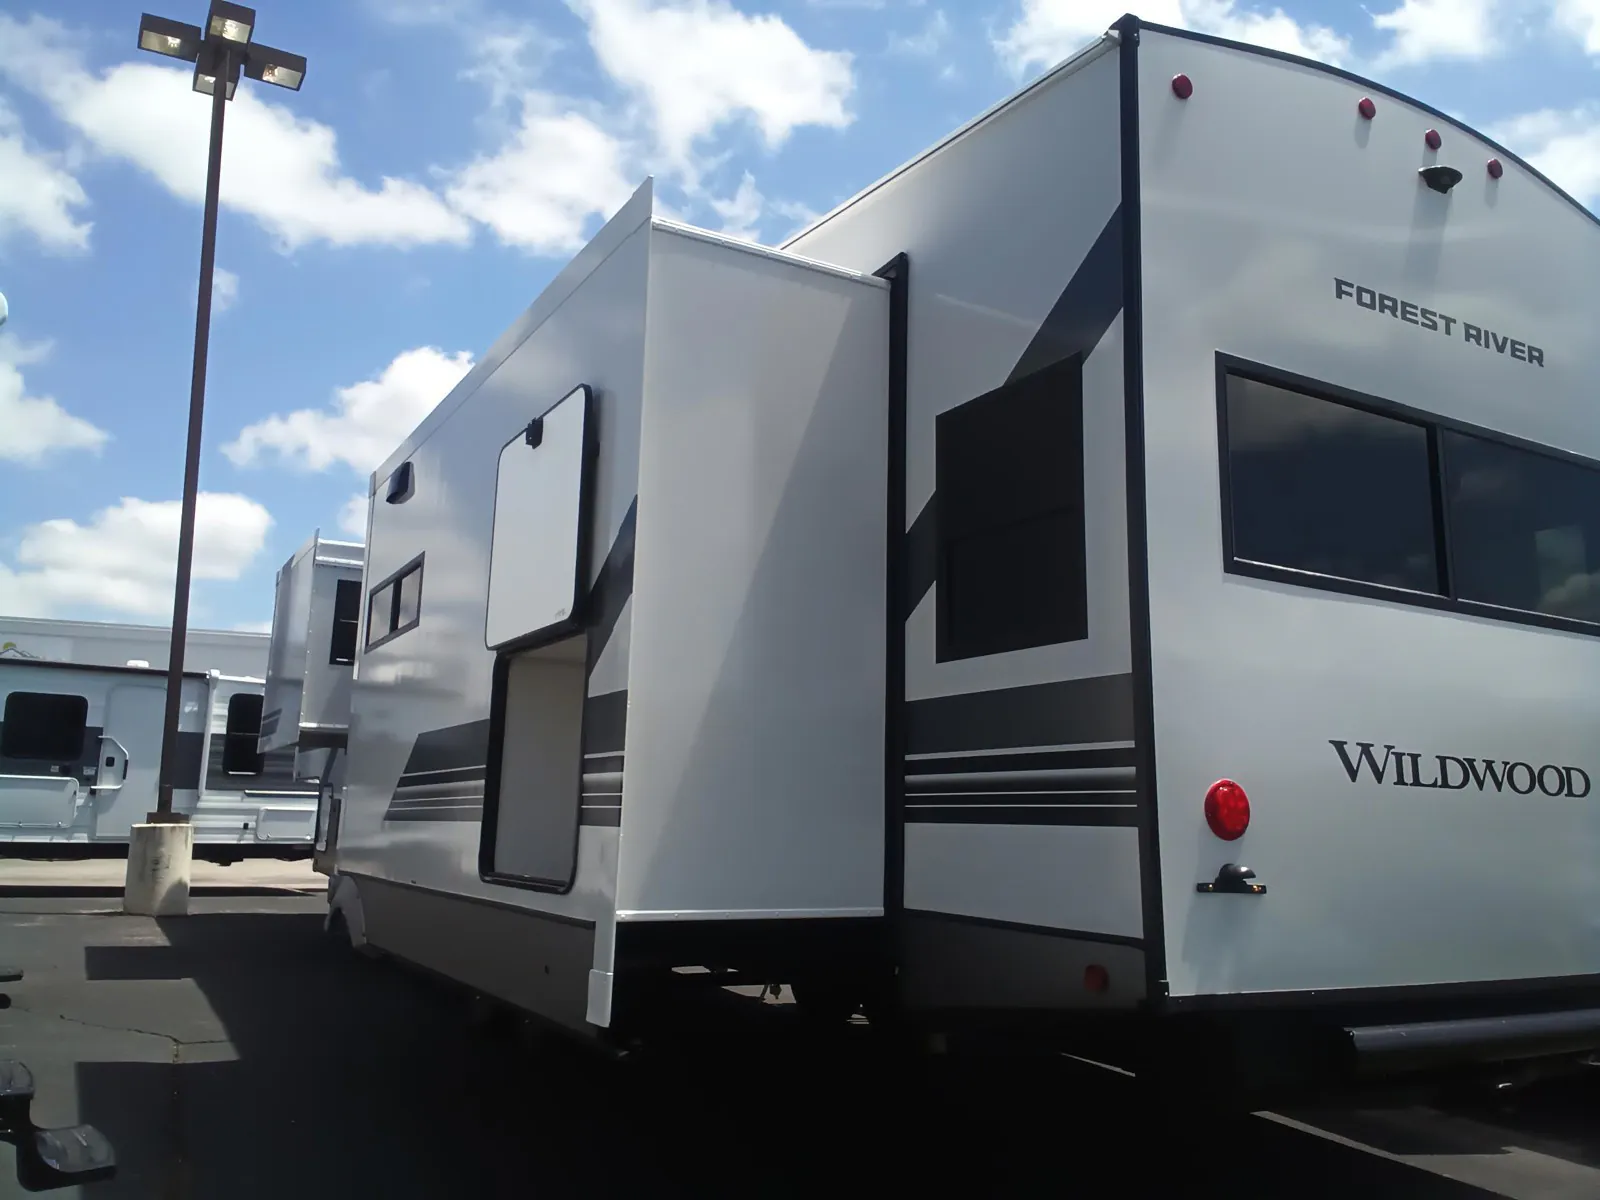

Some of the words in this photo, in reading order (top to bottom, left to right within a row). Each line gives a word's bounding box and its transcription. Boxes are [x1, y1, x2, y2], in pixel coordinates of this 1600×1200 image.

[1334, 277, 1457, 336] FOREST
[1463, 322, 1544, 368] RIVER
[1328, 739, 1591, 798] WILDWOOD
